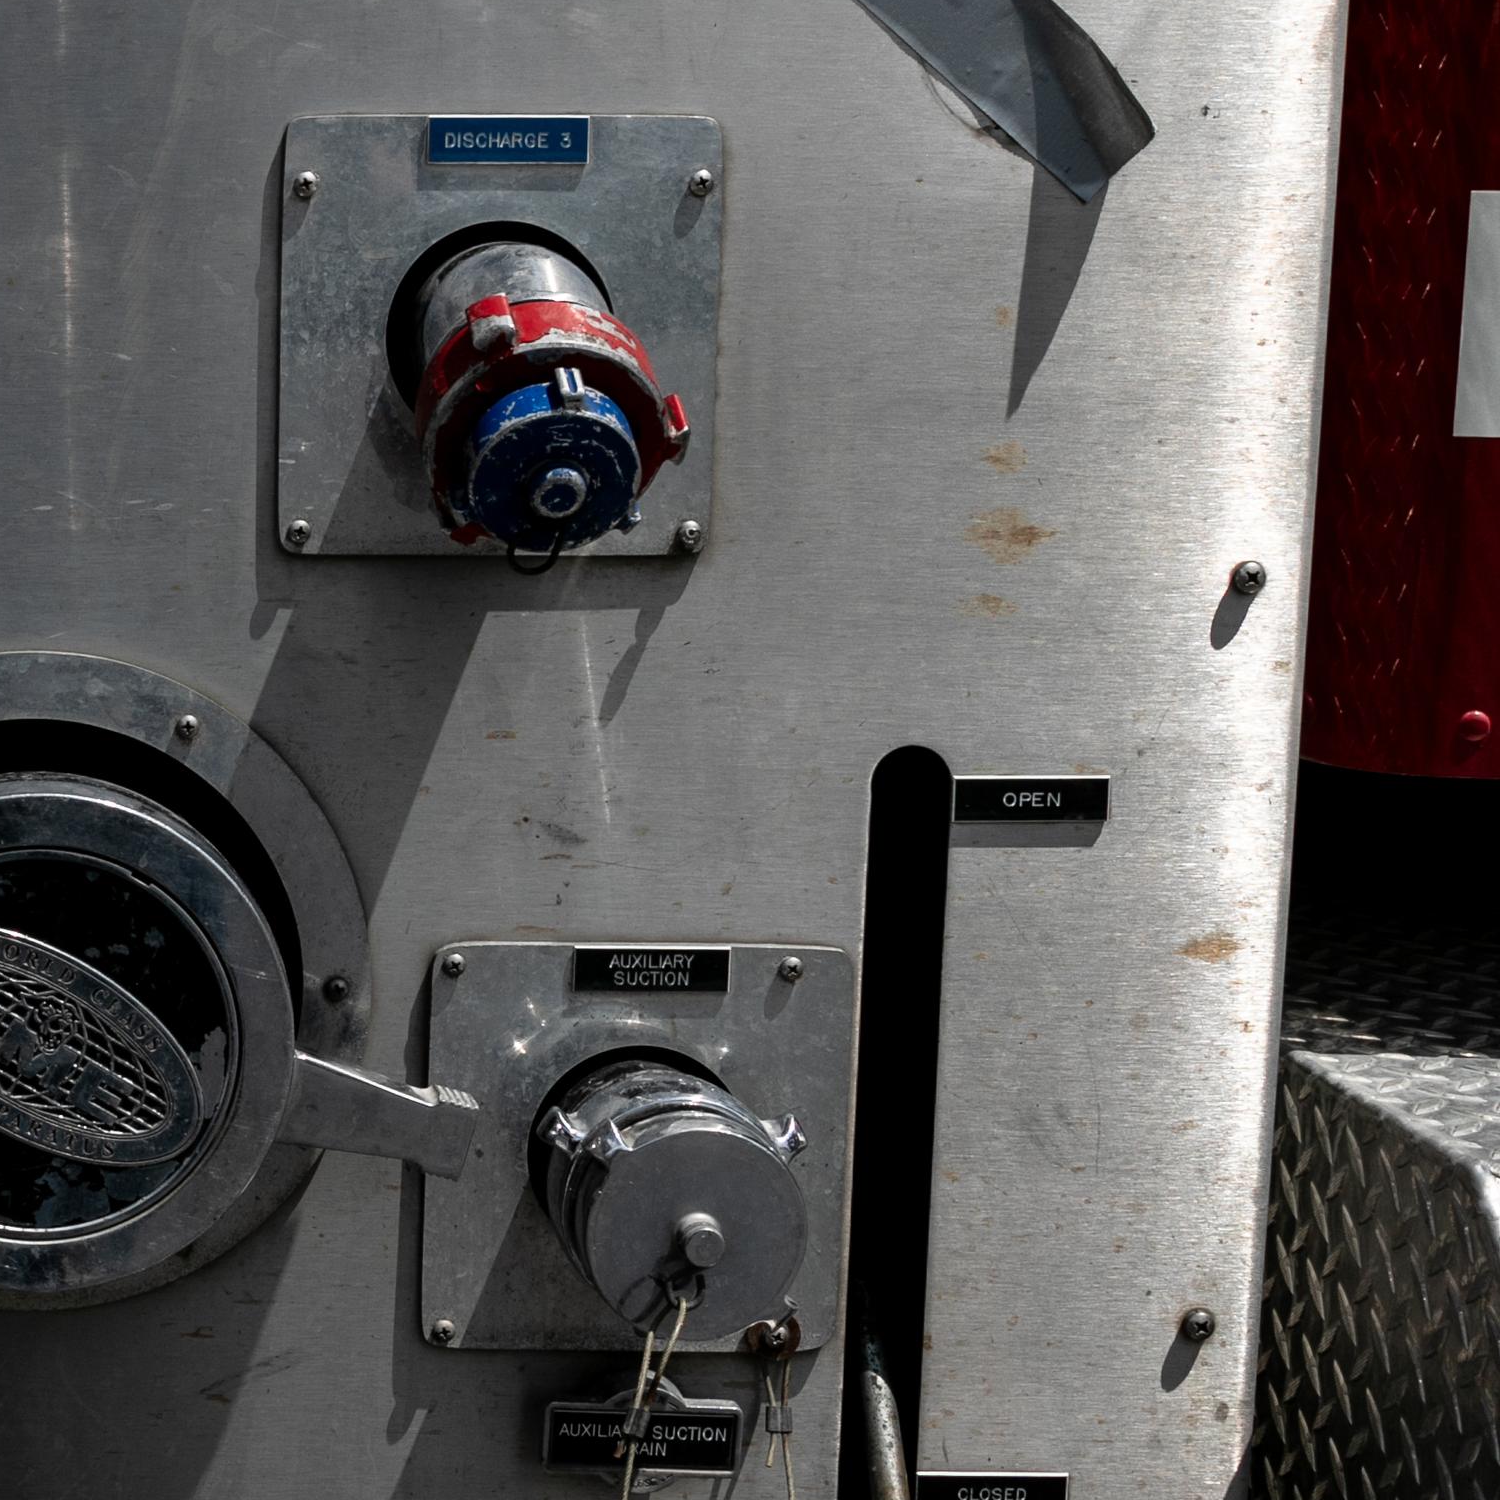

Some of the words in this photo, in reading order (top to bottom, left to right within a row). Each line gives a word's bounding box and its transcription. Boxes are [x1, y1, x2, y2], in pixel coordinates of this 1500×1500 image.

[444, 132, 549, 149] DISCHARGE
[560, 132, 572, 149] 3
[1002, 792, 1061, 807] OPEN
[609, 954, 694, 969] AUXILIARY
[614, 971, 689, 986] SUCTION
[90, 987, 164, 1052] CLASS
[558, 1422, 632, 1438] AUXILIA
[652, 1425, 727, 1442] SUCTION
